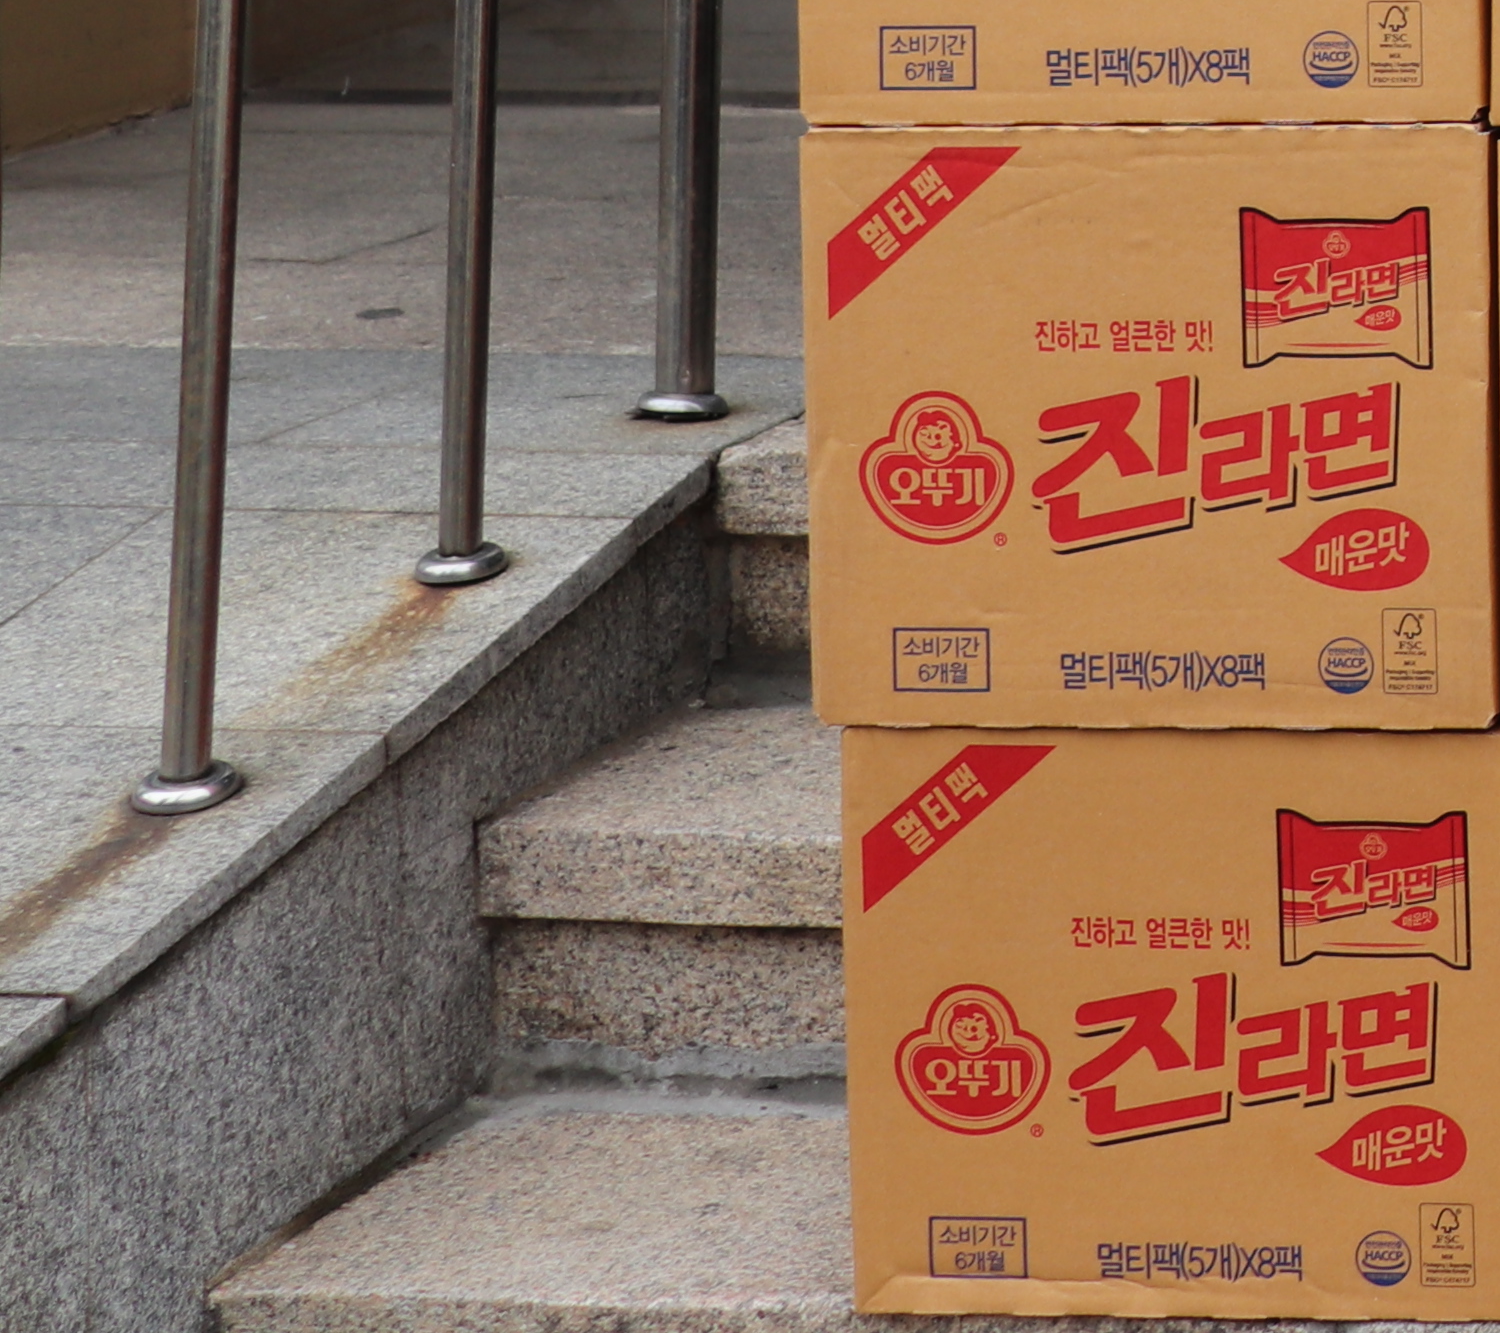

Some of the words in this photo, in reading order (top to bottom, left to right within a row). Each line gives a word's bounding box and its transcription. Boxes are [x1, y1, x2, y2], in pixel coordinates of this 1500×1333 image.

[1031, 375, 1402, 557] 진라면
[1314, 521, 1410, 577] 매운맛
[902, 636, 980, 658] 소비기간
[919, 662, 969, 684] 6개월
[925, 1058, 1021, 1098] 오뚜기
[1067, 973, 1439, 1151] 진라면
[1352, 1117, 1447, 1173] 매운맛
